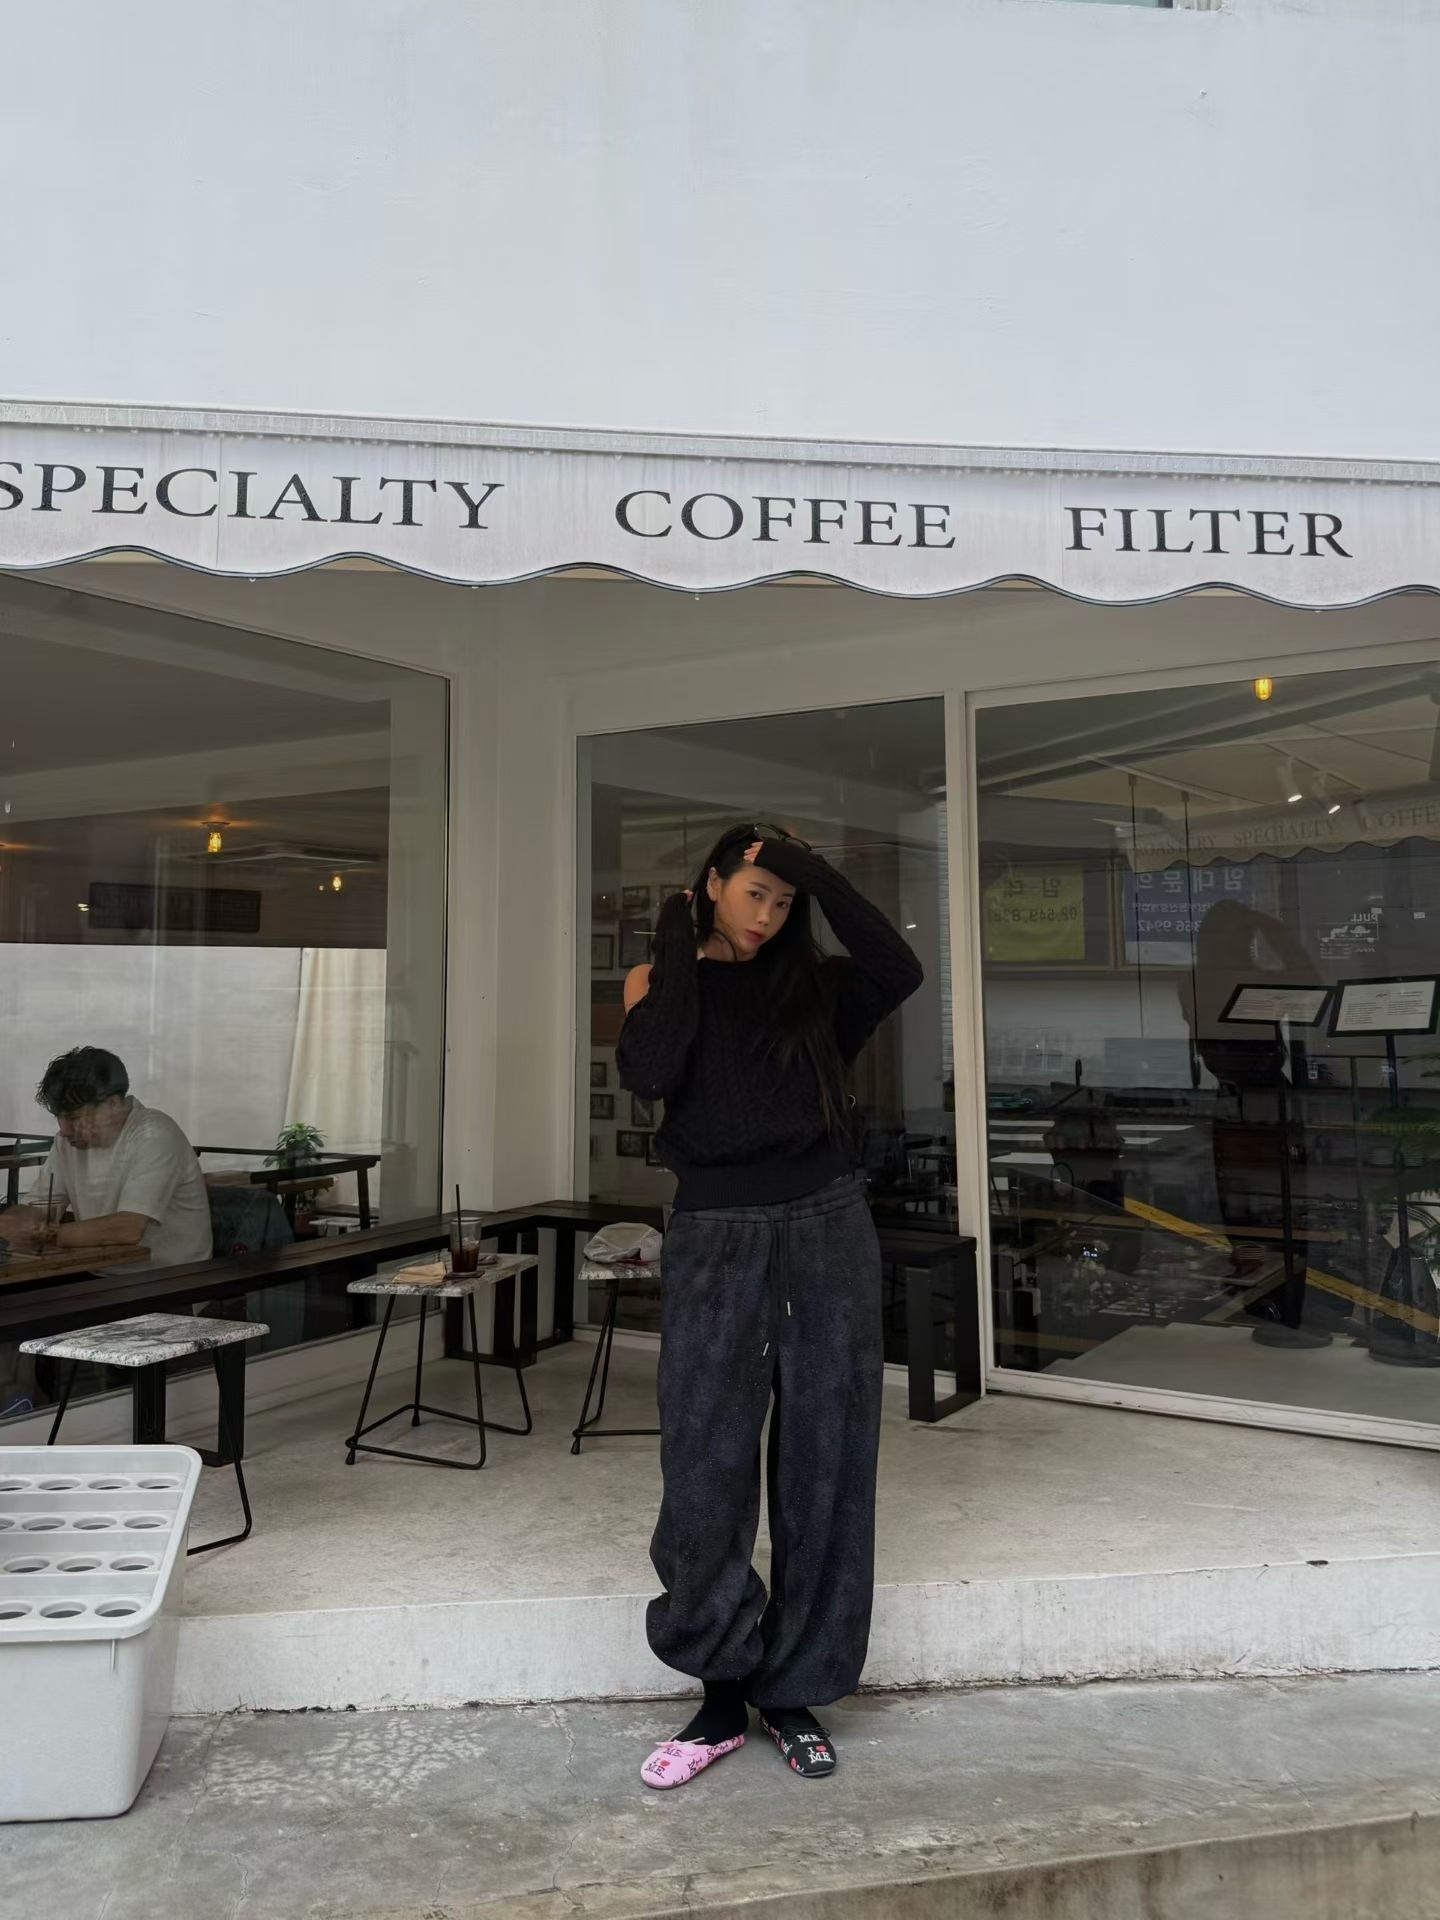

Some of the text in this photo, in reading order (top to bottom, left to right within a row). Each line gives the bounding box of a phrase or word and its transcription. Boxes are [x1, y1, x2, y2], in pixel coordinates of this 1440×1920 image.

[0, 460, 1354, 558] SPECIALTY COFFEE FILTER
